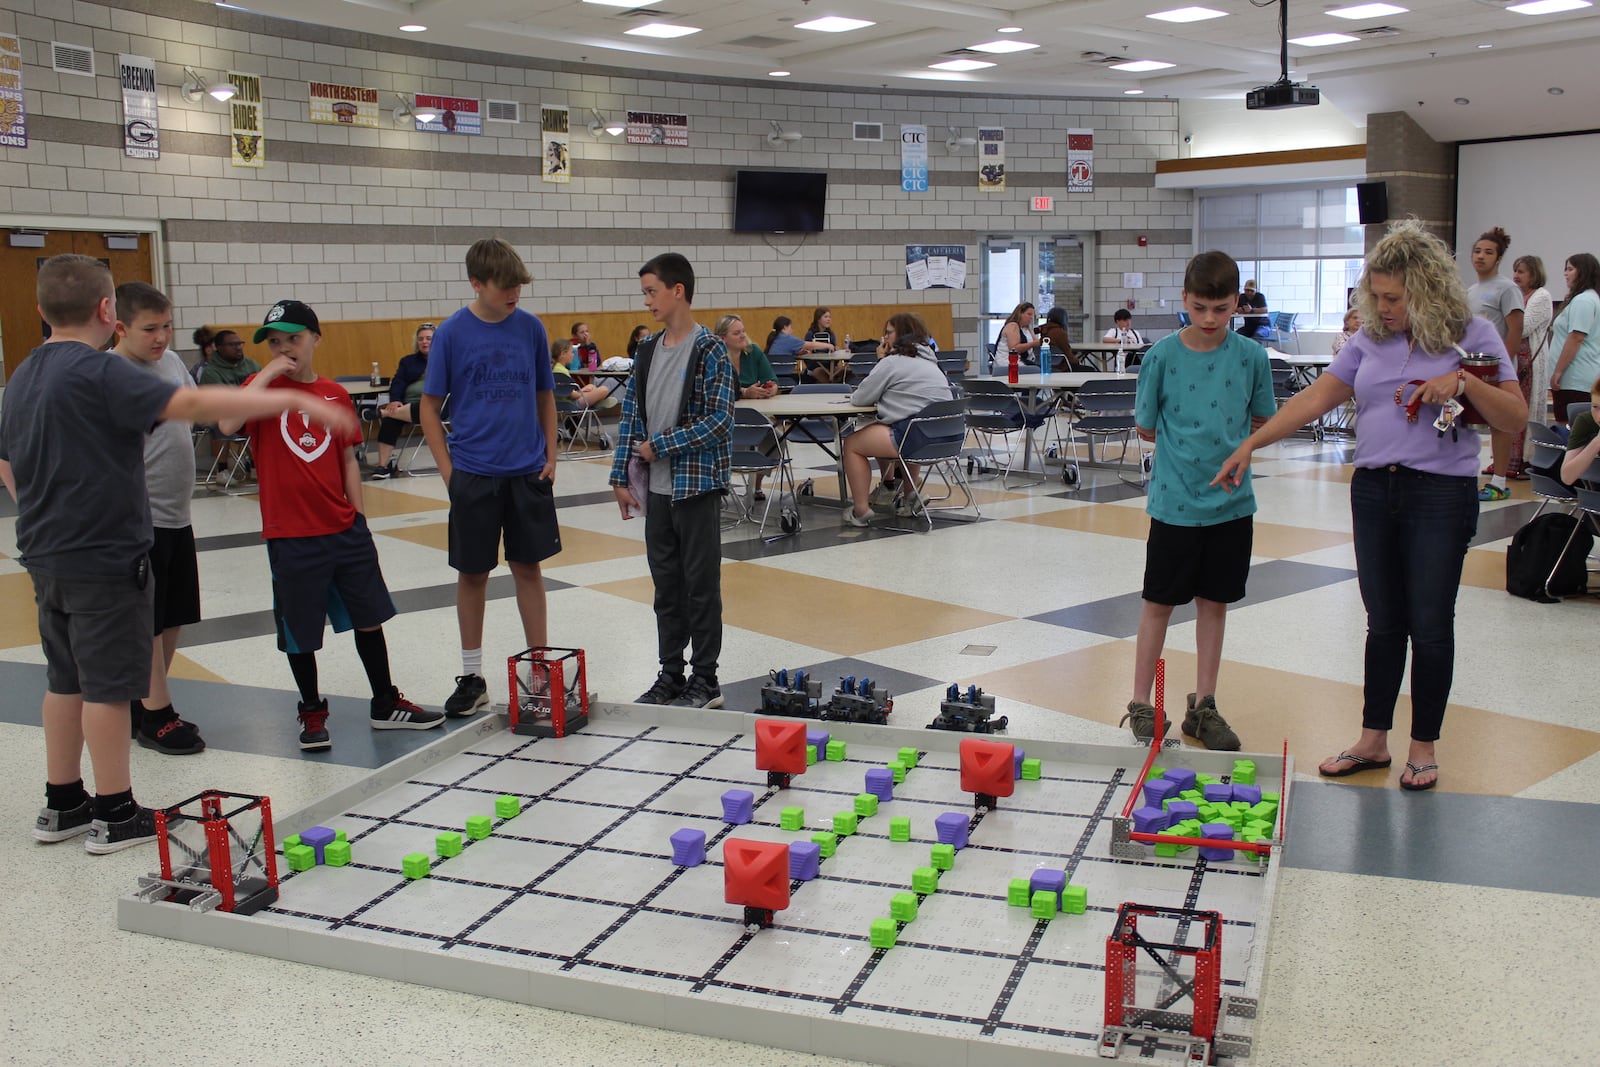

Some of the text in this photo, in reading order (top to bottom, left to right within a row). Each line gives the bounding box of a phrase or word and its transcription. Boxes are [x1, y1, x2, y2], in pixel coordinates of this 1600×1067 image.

[121, 64, 155, 92] GREENON
[310, 82, 378, 103] NORTHEASTERN
[233, 103, 257, 131] RIDGE
[627, 112, 687, 127] SOUTHEASTERN
[627, 127, 652, 136] TROJAN
[664, 129, 687, 138] OJANS
[627, 135, 653, 145] TROJAN
[664, 138, 688, 147] OJANS
[902, 132, 926, 144] CTC
[902, 167, 926, 179] CTC
[902, 179, 926, 191] CTC
[1035, 197, 1050, 209] EXIT
[928, 247, 964, 256] CAFETERIA
[475, 390, 522, 400] STUDIOS
[520, 703, 541, 712] VEX
[603, 706, 632, 718] VEX
